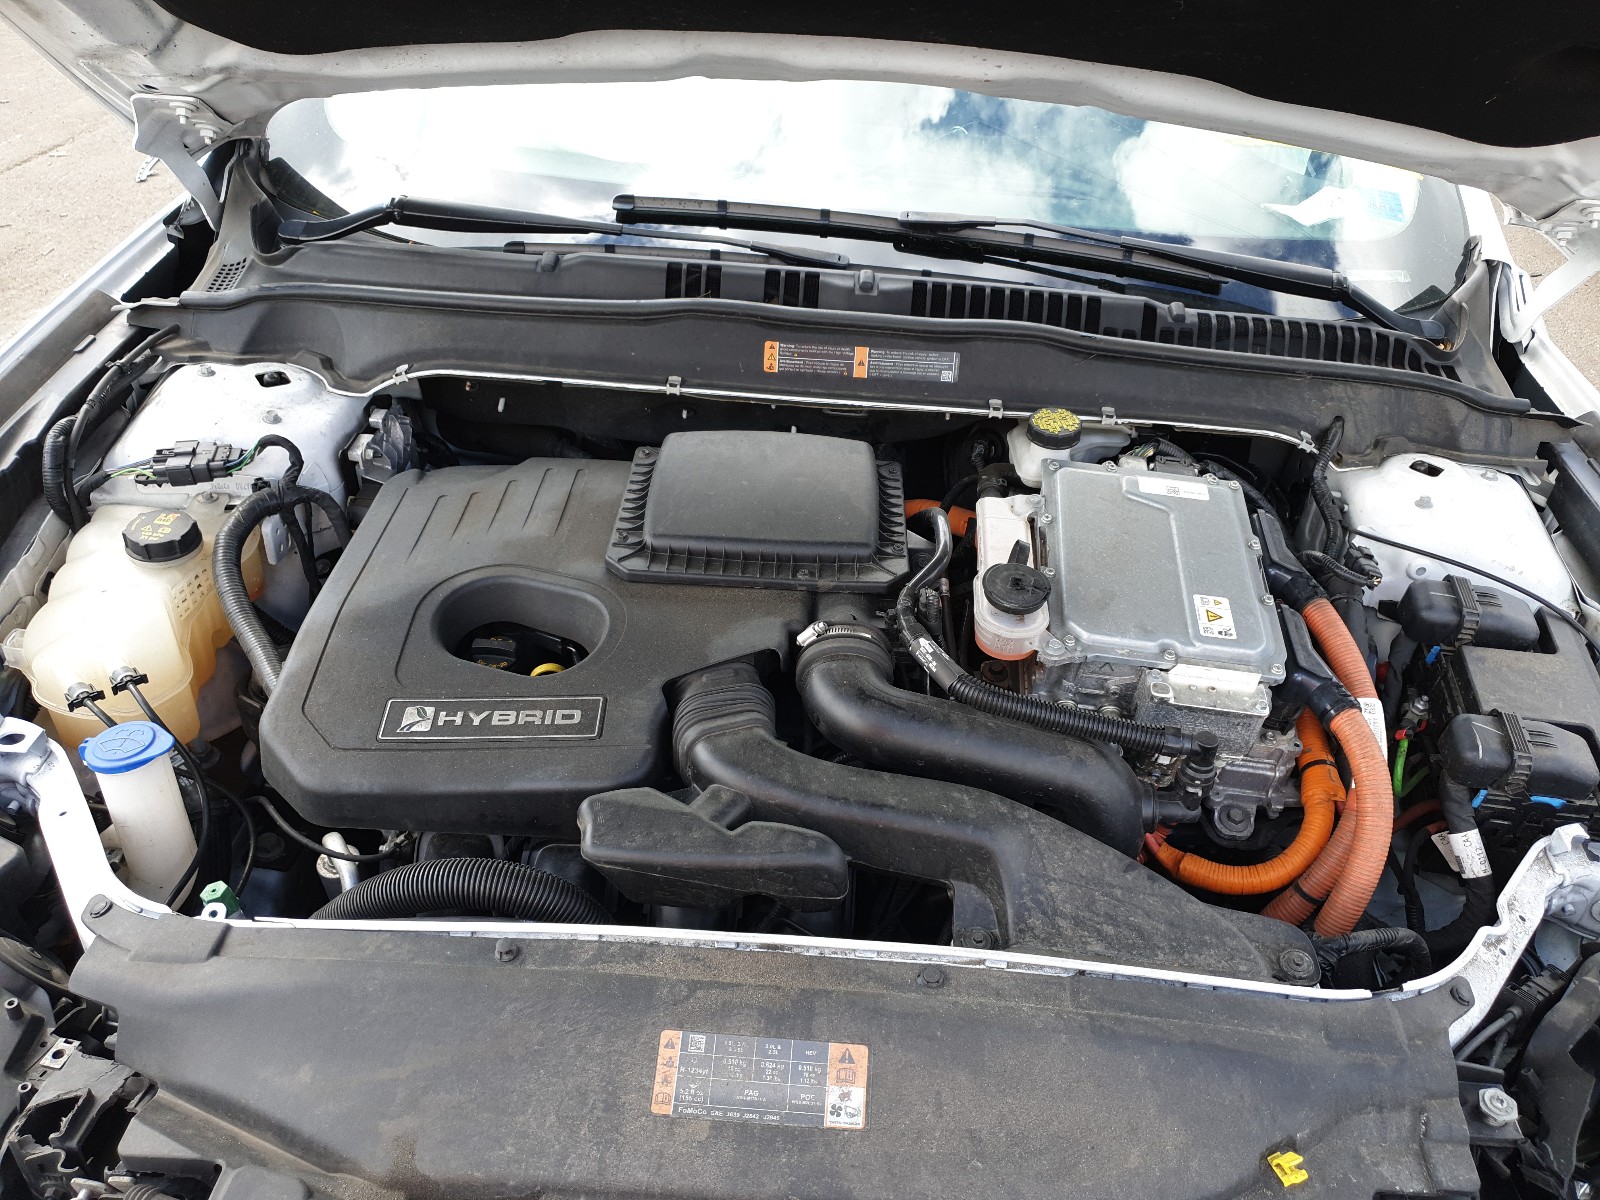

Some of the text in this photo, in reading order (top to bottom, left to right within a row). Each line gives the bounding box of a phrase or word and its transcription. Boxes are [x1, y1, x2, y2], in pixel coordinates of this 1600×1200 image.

[438, 710, 582, 726] HYBRID
[680, 1066, 709, 1076] R-1234yf
[678, 1107, 707, 1115] FoMoCo
